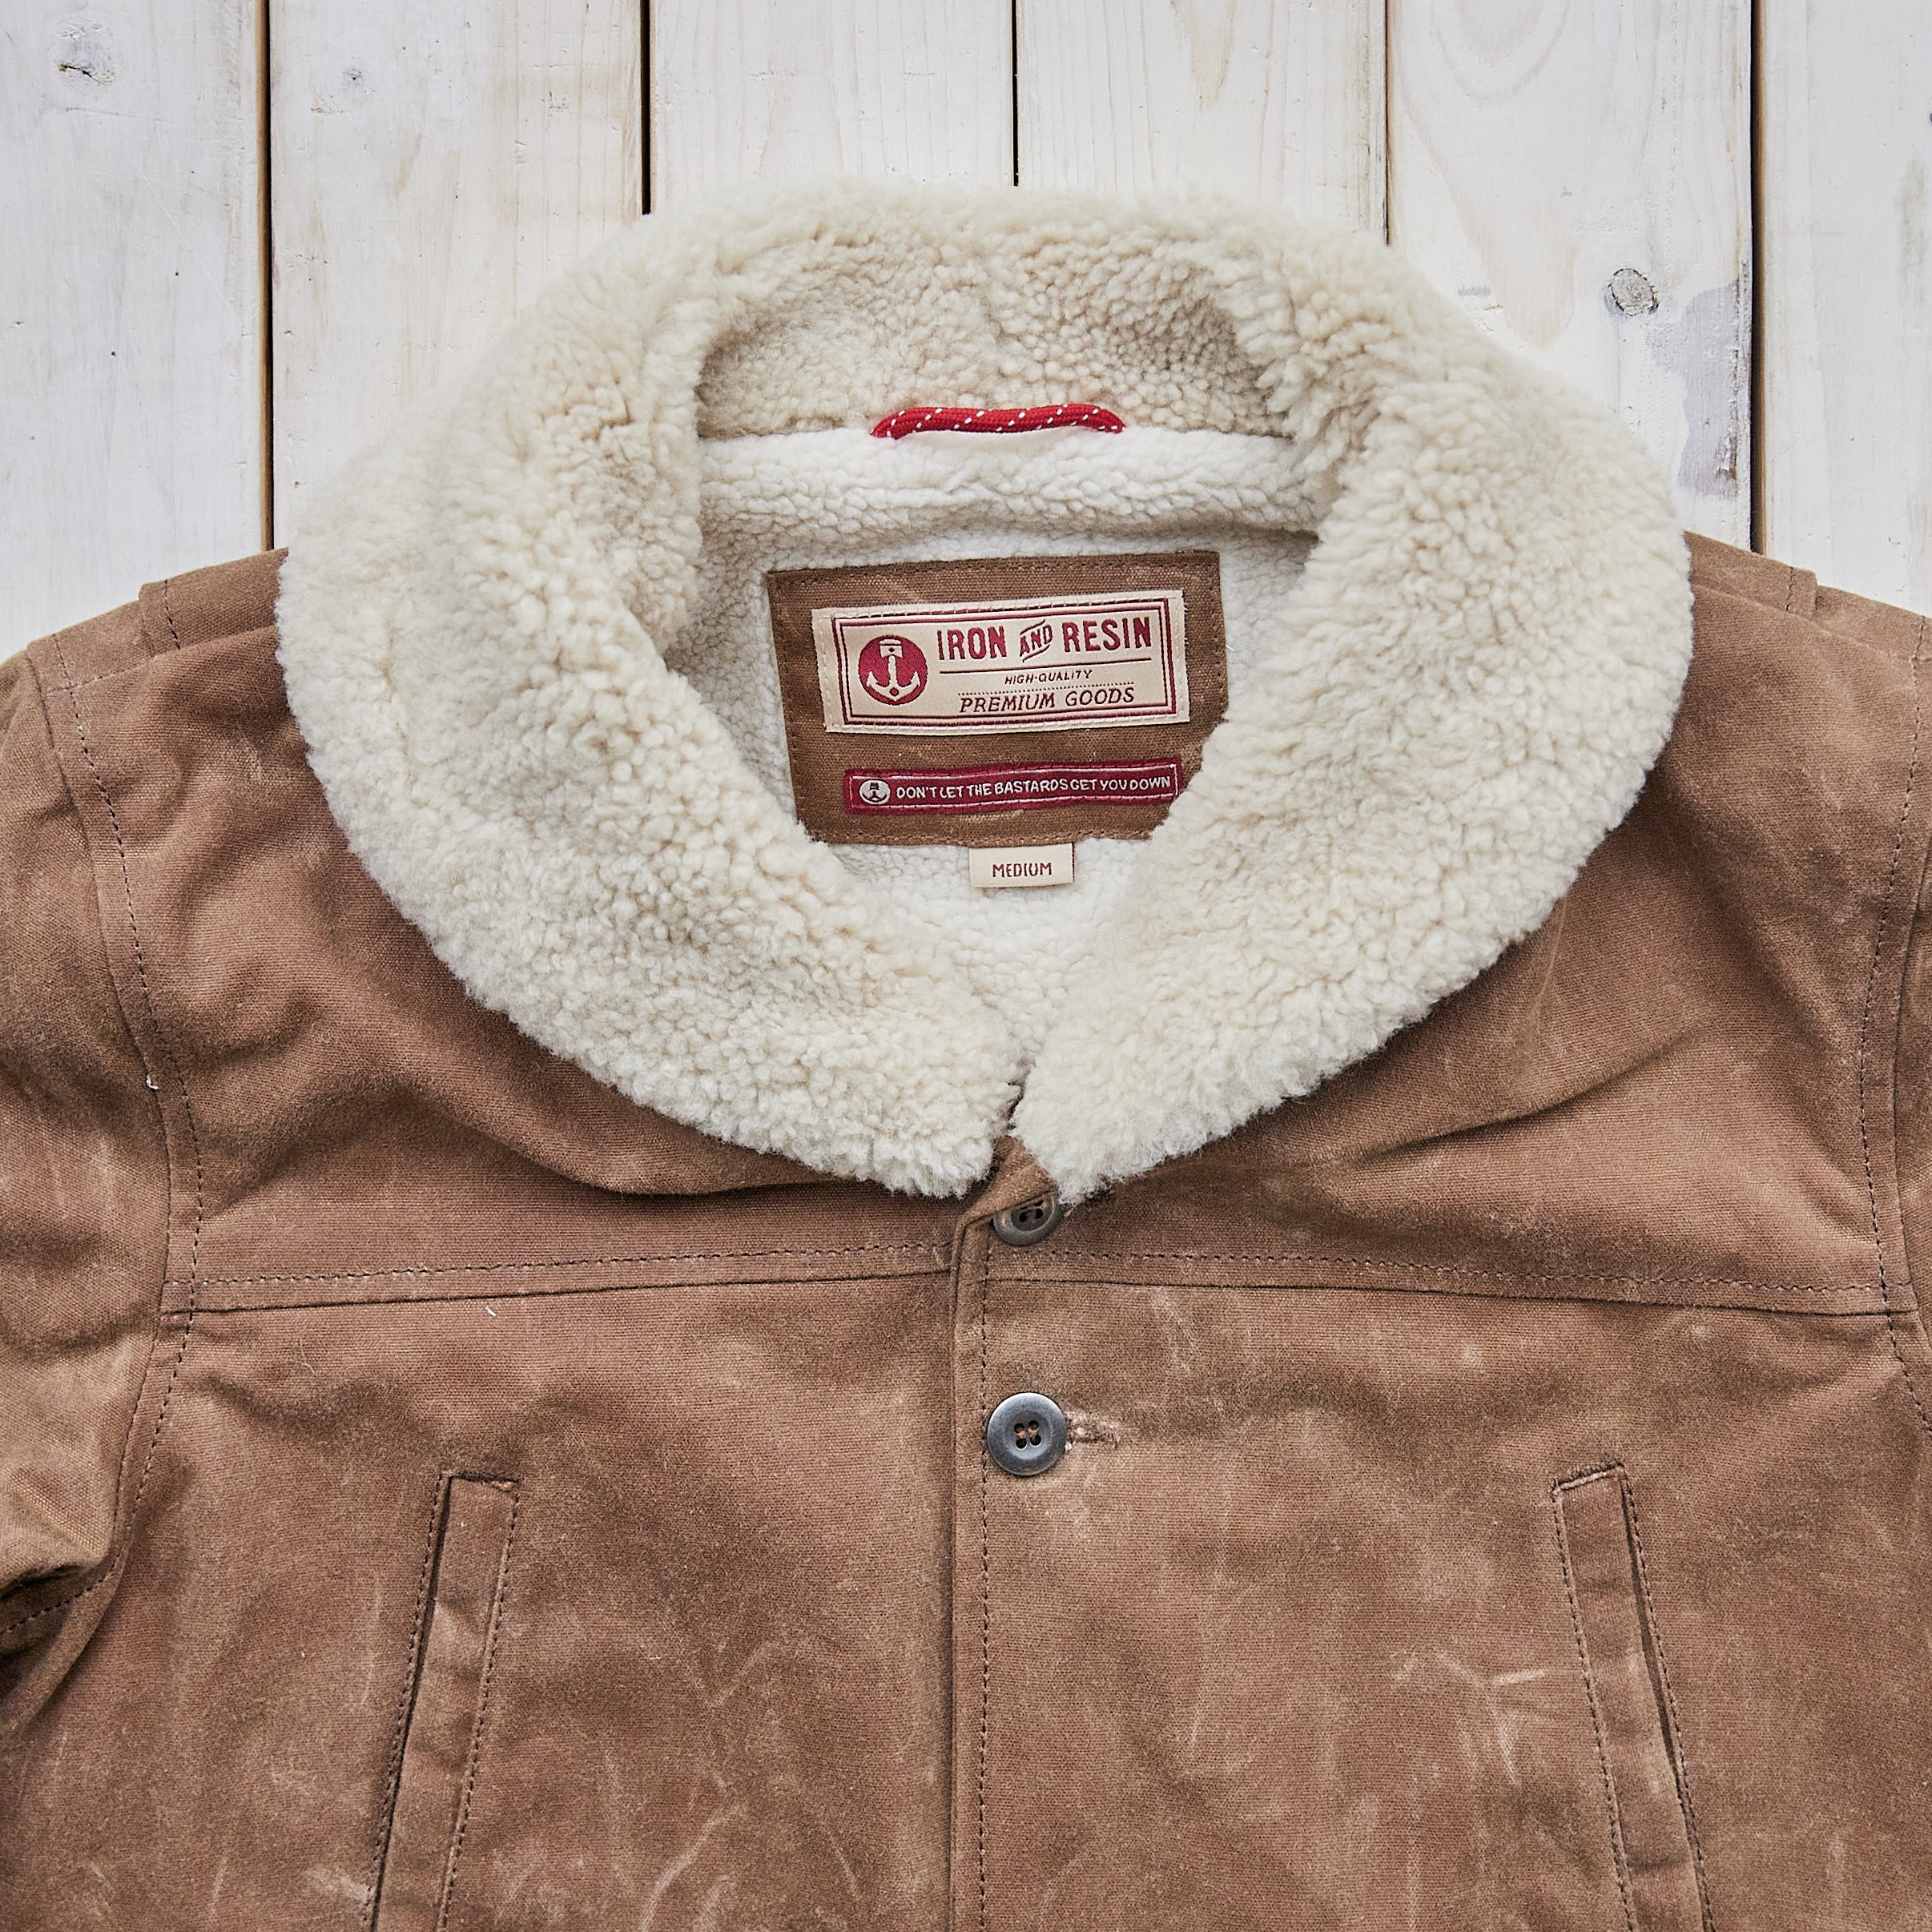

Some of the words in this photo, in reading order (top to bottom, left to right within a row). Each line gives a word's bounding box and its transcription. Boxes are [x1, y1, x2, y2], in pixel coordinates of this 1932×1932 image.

[937, 626, 1008, 661] IRON
[1019, 626, 1053, 658] AND
[1061, 616, 1152, 654] RESIN
[1004, 670, 1093, 686] HIGH-QUALITY
[960, 693, 1056, 714] PREMIUM
[1065, 687, 1135, 707] GOODS
[896, 786, 937, 799] DON'T
[940, 784, 964, 799] LET
[968, 783, 992, 797] THE
[993, 778, 1069, 795] BASTARDS
[1069, 779, 1098, 791] GET
[1100, 778, 1129, 792] YOU
[1129, 775, 1171, 791] DOWN
[992, 862, 1053, 879] MEDIUM
